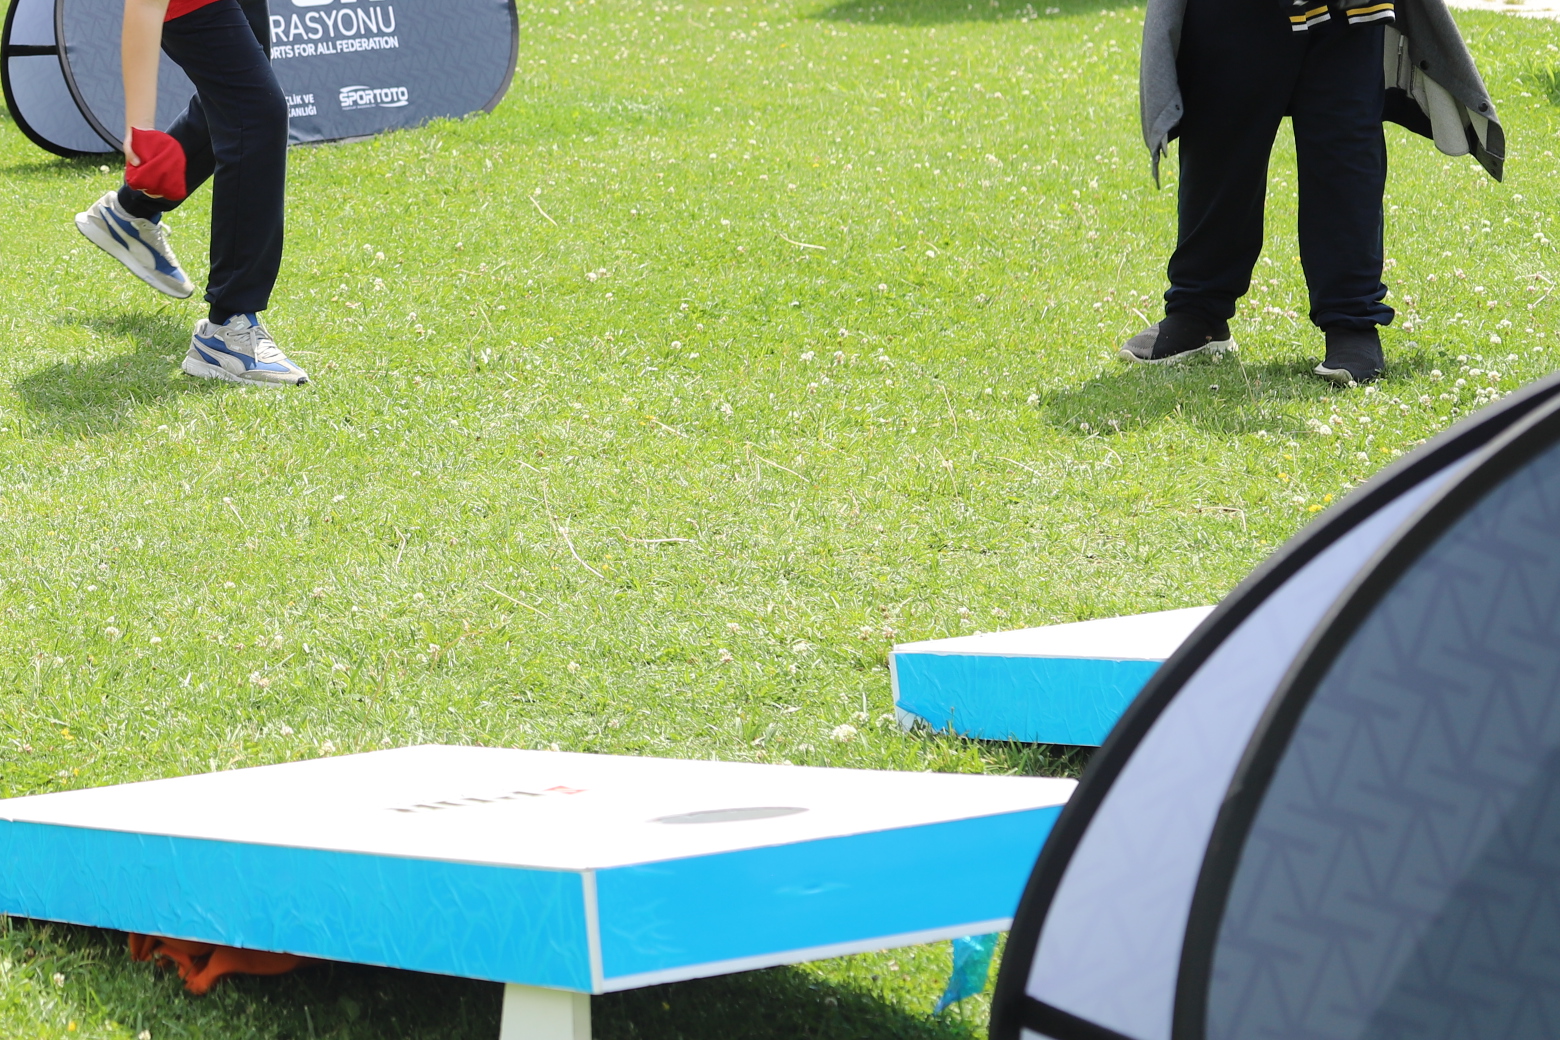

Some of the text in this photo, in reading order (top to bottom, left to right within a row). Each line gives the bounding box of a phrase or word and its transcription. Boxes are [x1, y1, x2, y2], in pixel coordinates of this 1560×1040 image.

[269, 5, 396, 43] RASYONU
[294, 43, 316, 57] FOR
[317, 41, 336, 55] ALL
[336, 36, 399, 53] FEDERATION
[302, 93, 315, 104] VE
[339, 86, 409, 107] SPORTOTO
[287, 104, 317, 118] ANLIĞI
